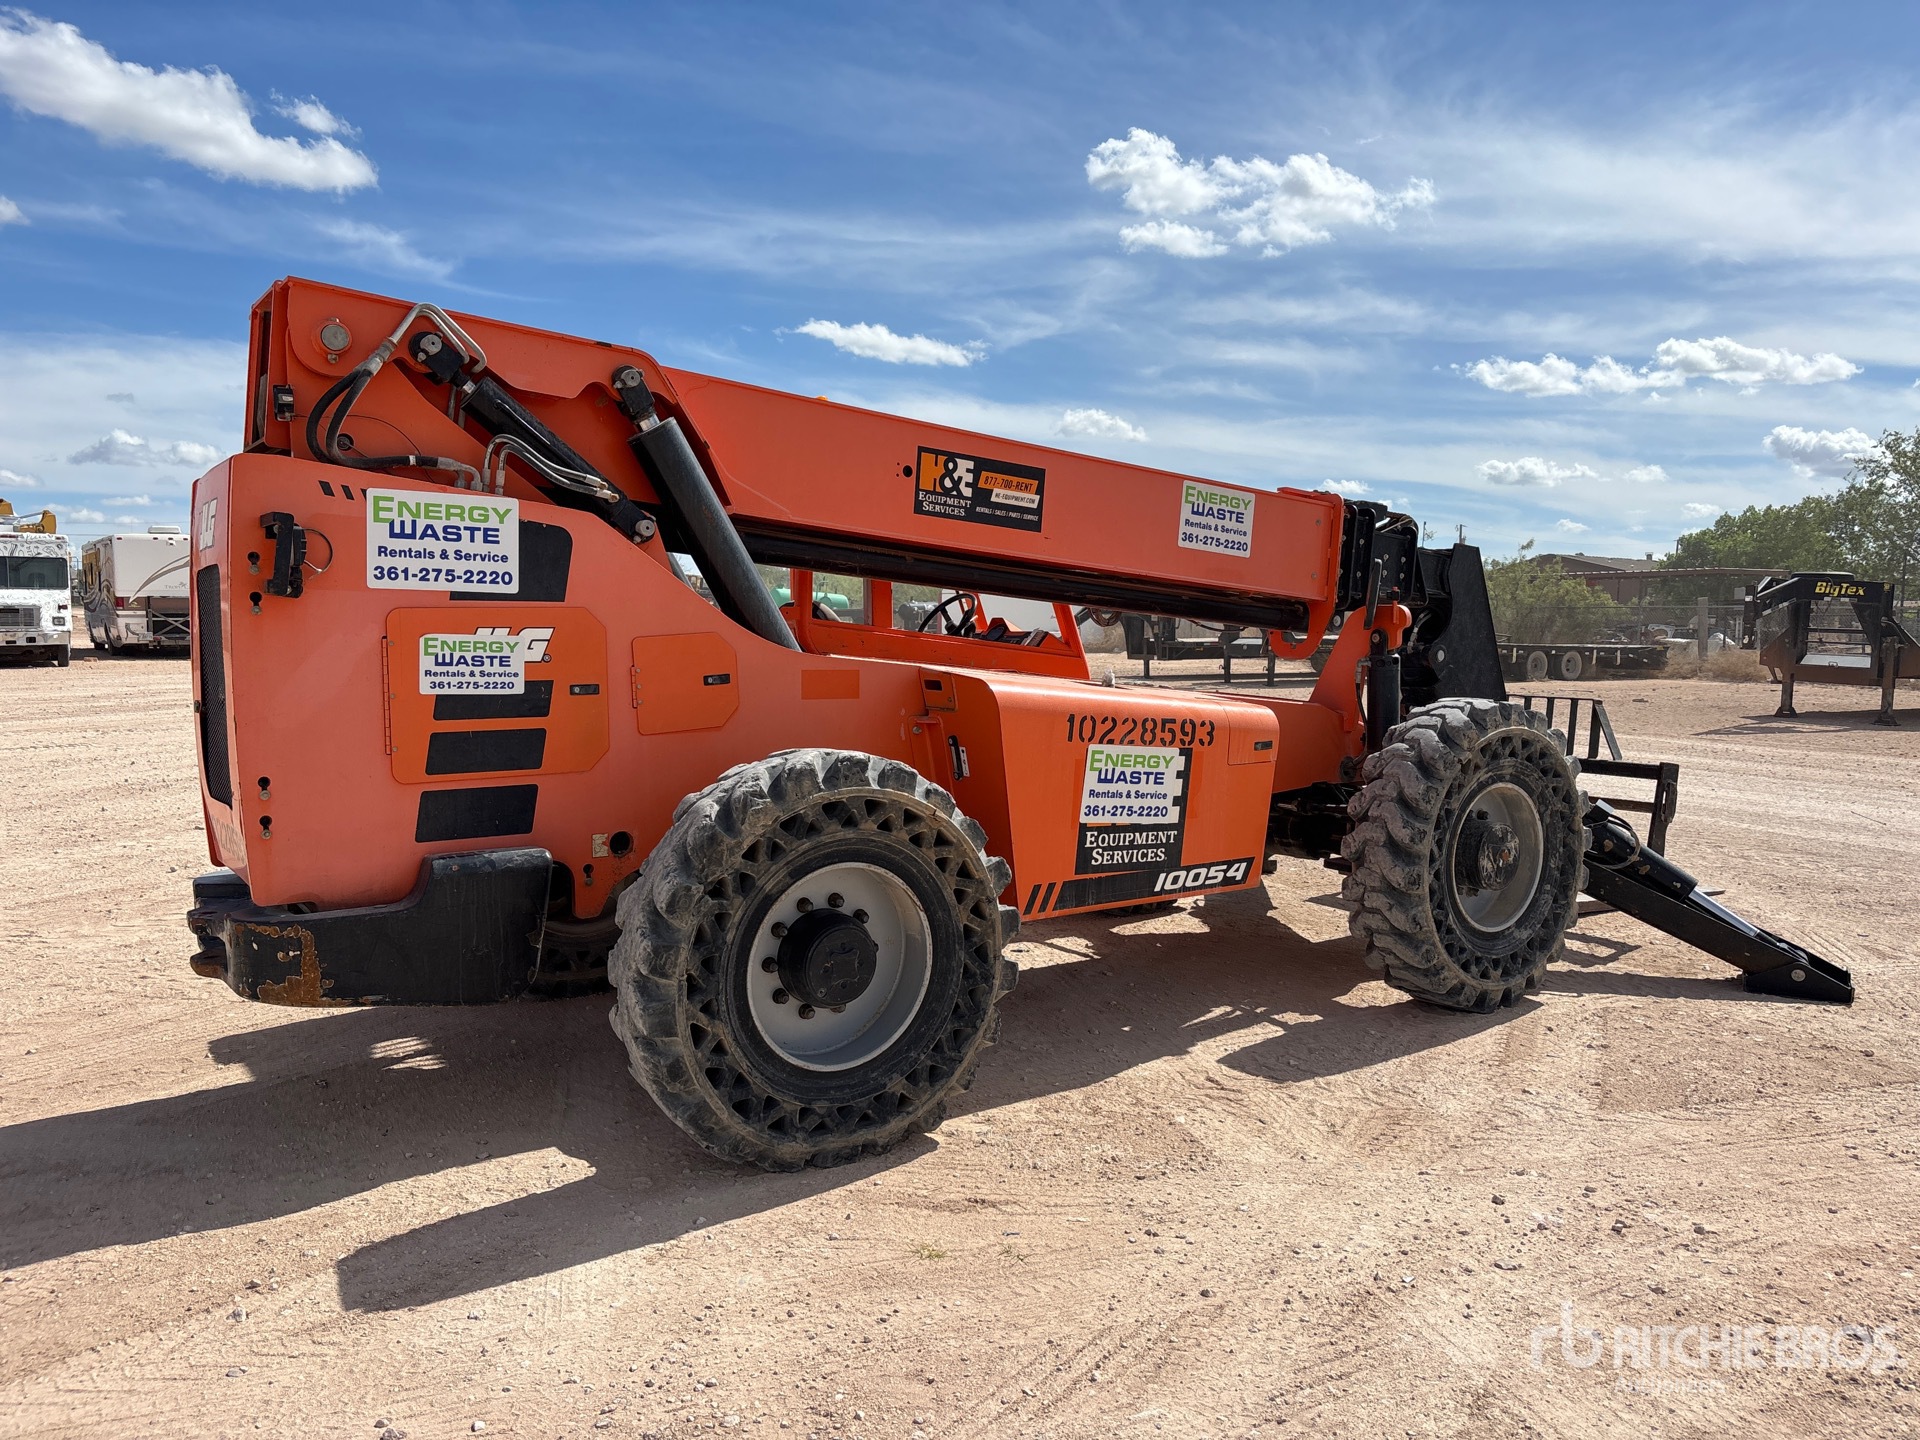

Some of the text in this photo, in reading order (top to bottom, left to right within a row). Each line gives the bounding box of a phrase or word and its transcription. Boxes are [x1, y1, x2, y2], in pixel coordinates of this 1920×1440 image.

[919, 452, 974, 497] H&E
[983, 475, 1034, 493] 877-700-RENT
[918, 491, 972, 508] EQUIPMENT
[1185, 485, 1252, 510] ENERGY
[373, 495, 513, 524] ENERGY
[922, 501, 966, 517] SERVICES
[1191, 502, 1245, 524] WASTE
[388, 519, 501, 545] WASTE
[1184, 518, 1248, 537] Rentals & Service
[1181, 532, 1249, 552] 361-275-2220
[377, 545, 509, 563] Rentals & Service
[373, 565, 513, 586] 361-275-2220
[1815, 581, 1867, 597] BigTex
[423, 637, 520, 657] ENERGY
[434, 652, 511, 668] WASTE
[424, 670, 519, 678] Rentals & Service
[429, 681, 515, 690] 361-275-2220
[1066, 713, 1216, 747] 10228593
[1089, 750, 1175, 772] ENERGY
[1097, 767, 1165, 785] WASTE
[1088, 789, 1168, 800] Rentals & Service
[1084, 805, 1168, 818] 361-275-2220
[1084, 831, 1178, 848] EQUIPMENT
[1091, 848, 1167, 866] SERVICES
[1153, 862, 1248, 892] 10054
